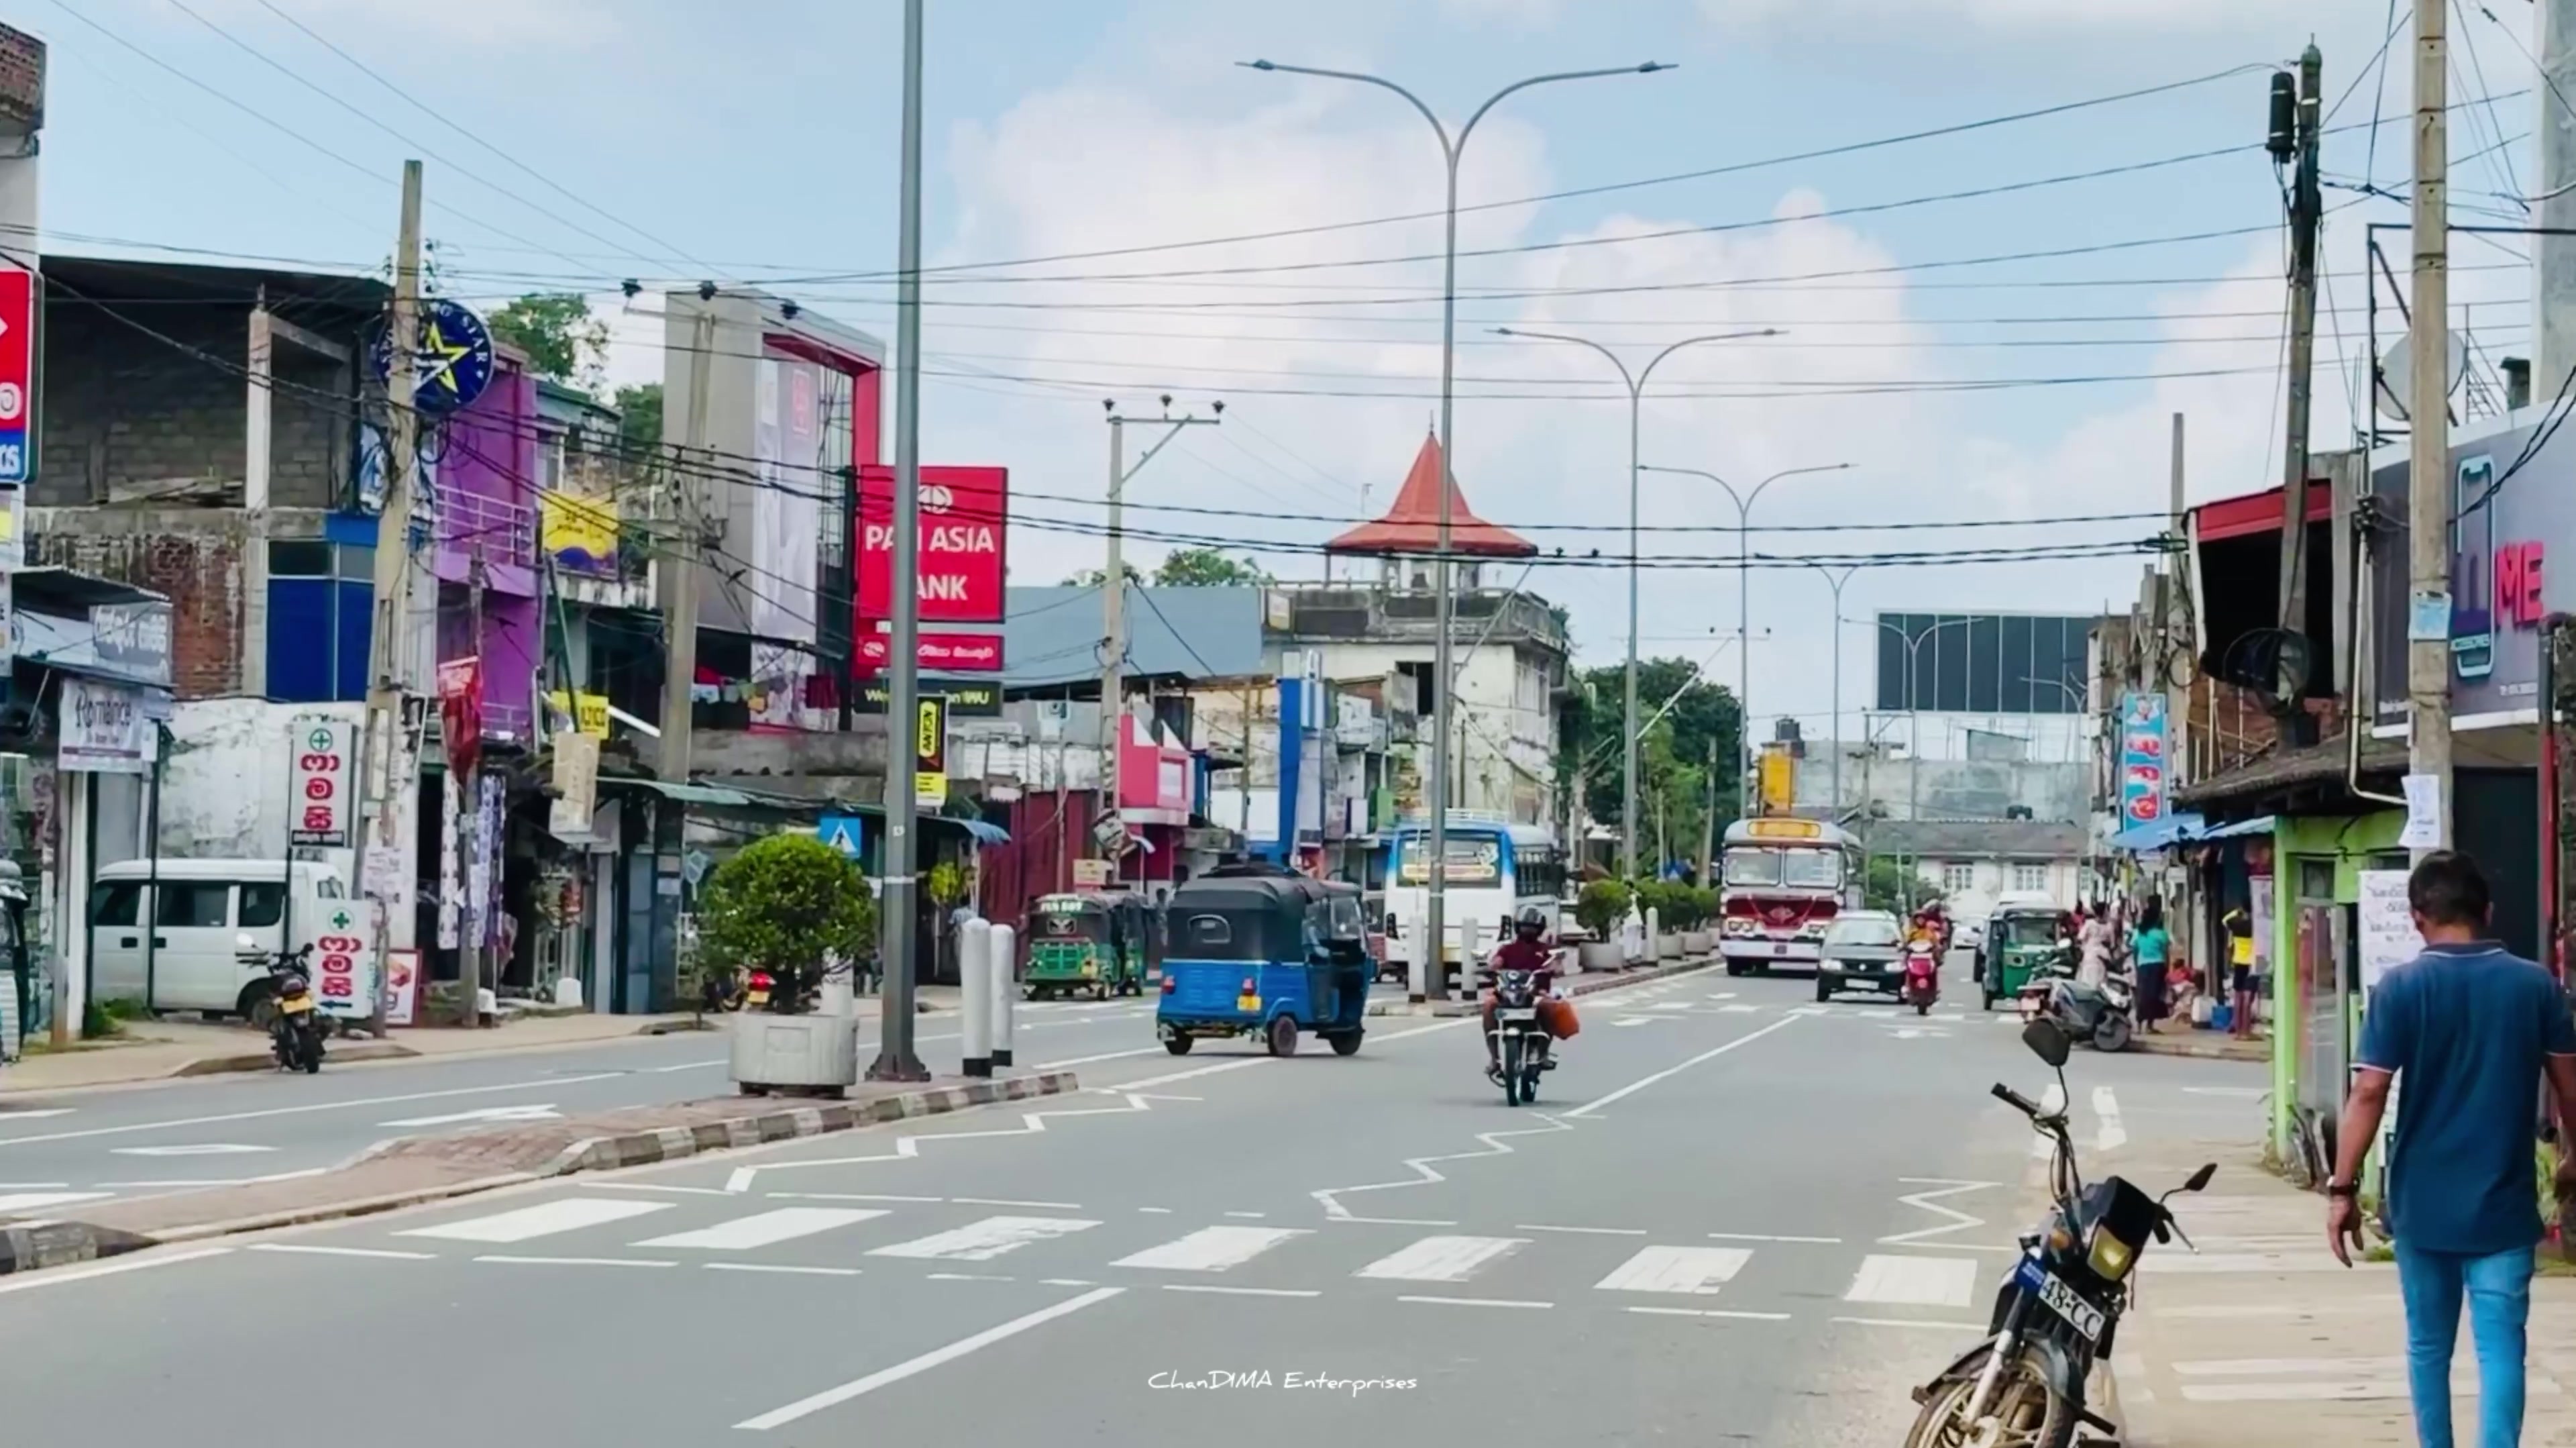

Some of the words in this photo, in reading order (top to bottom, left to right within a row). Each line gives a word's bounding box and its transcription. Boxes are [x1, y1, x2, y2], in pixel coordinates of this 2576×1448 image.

[865, 525, 922, 552] PA
[929, 526, 995, 553] ASIA
[916, 574, 968, 601] ANK
